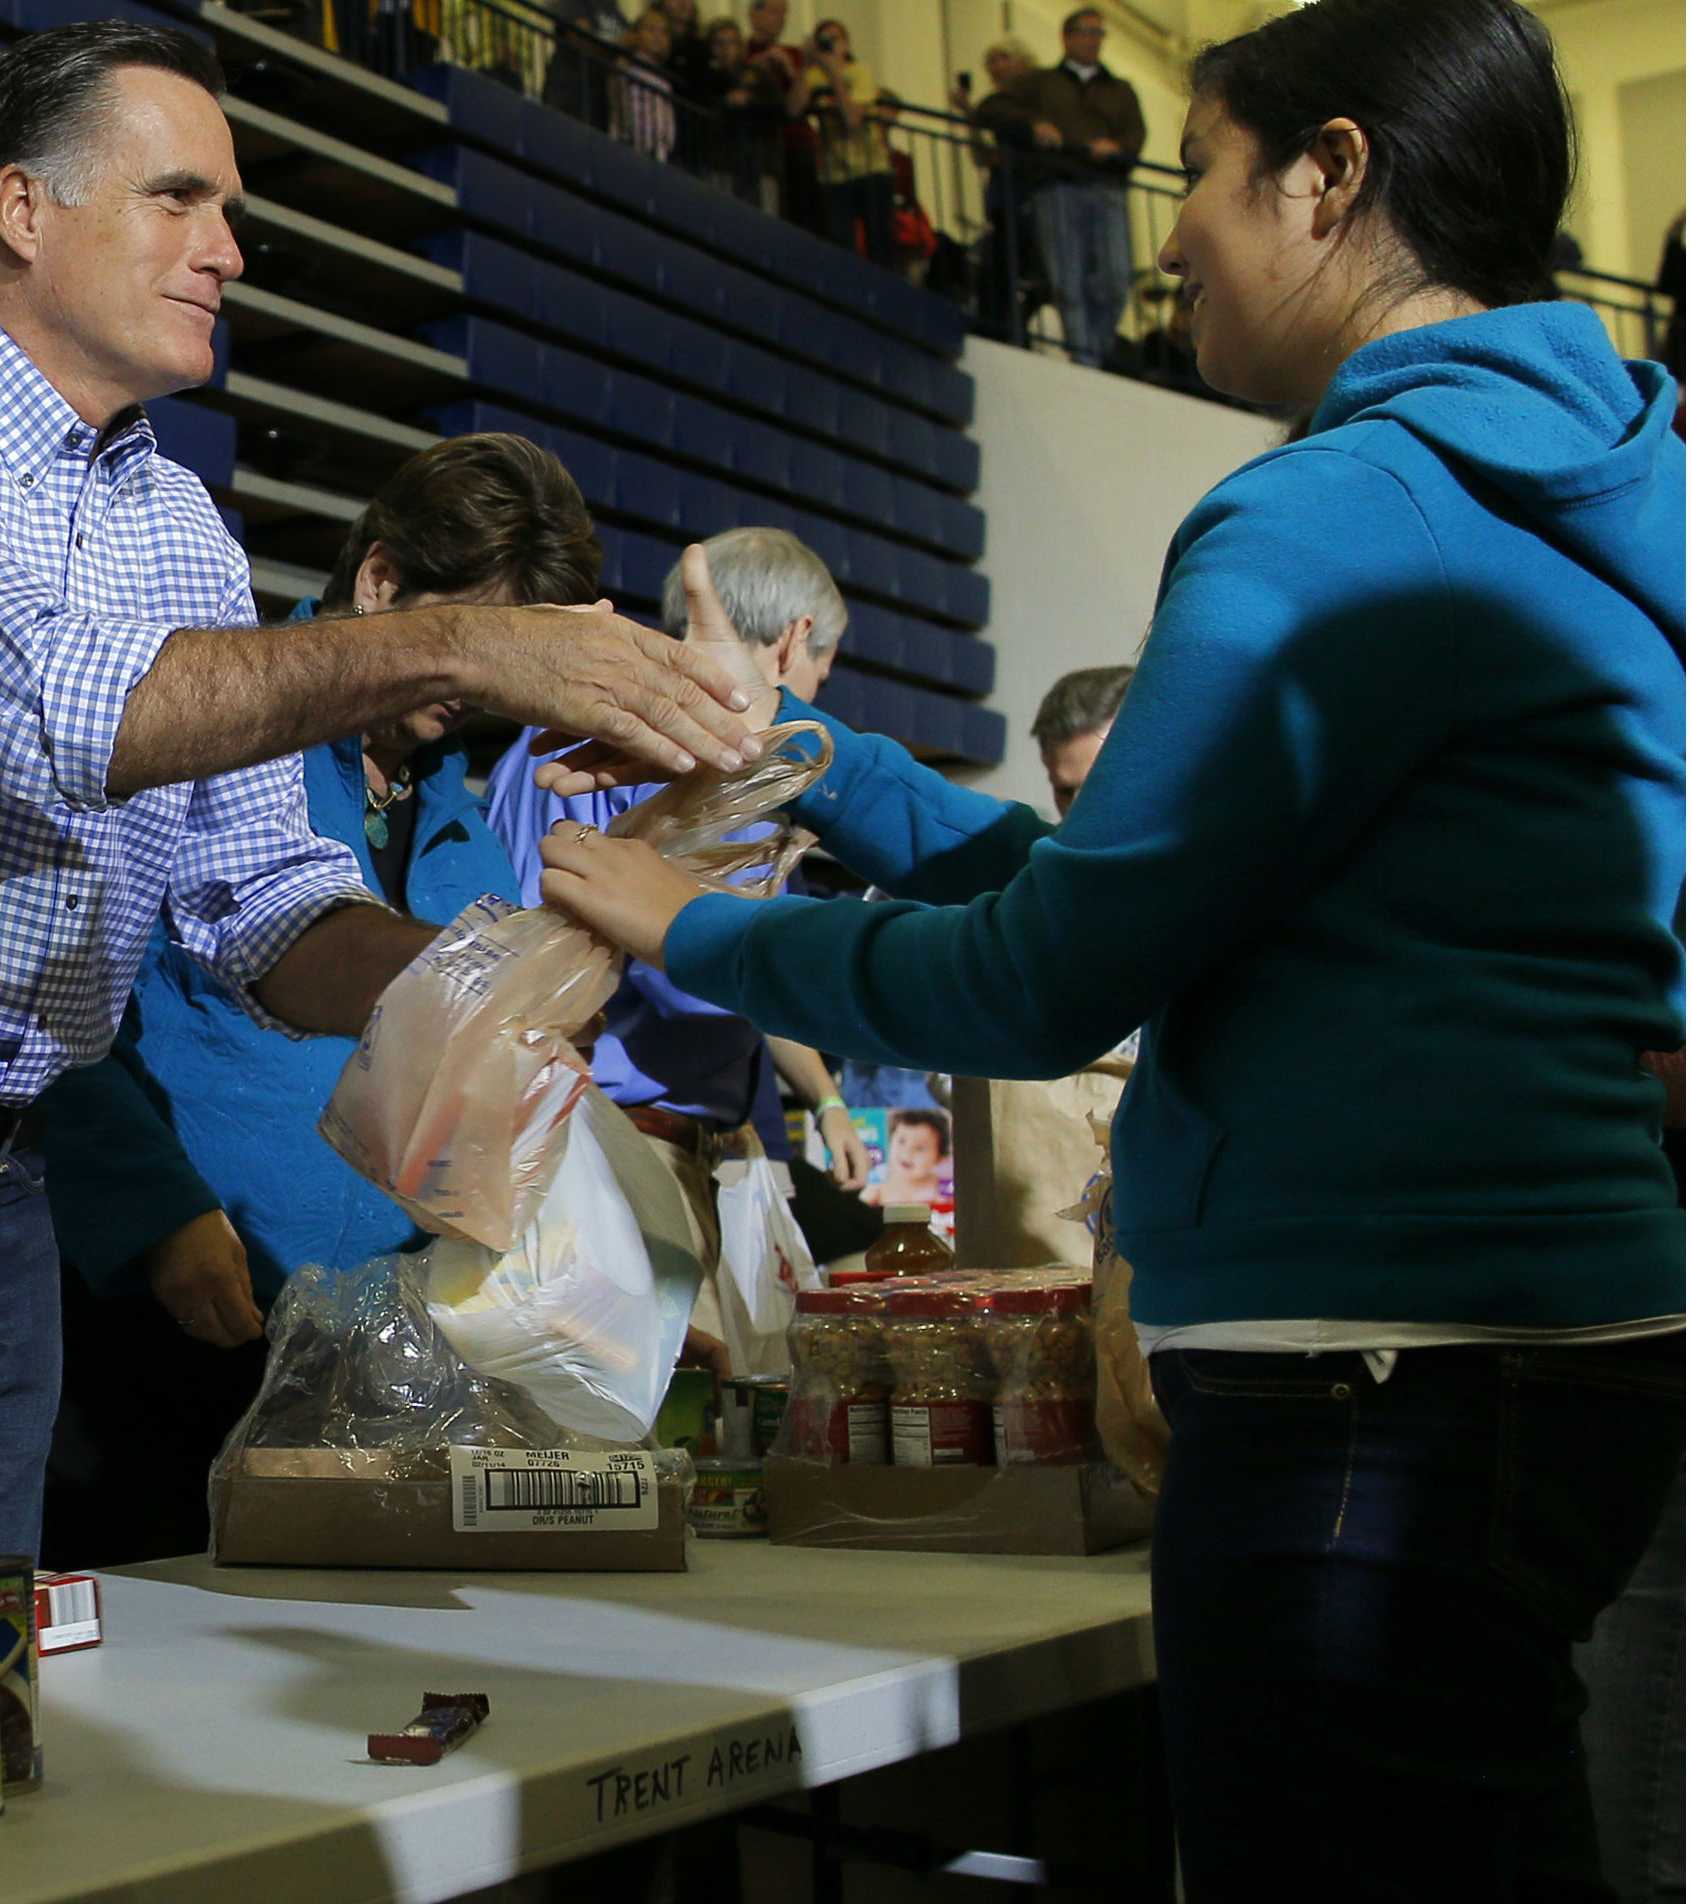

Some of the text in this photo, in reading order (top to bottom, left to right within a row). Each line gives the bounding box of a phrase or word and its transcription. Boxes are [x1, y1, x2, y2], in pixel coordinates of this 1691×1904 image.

[526, 1451, 570, 1460] MEIJER
[557, 1515, 595, 1525] PEANUT
[587, 1725, 803, 1823] TRENT ARENA
